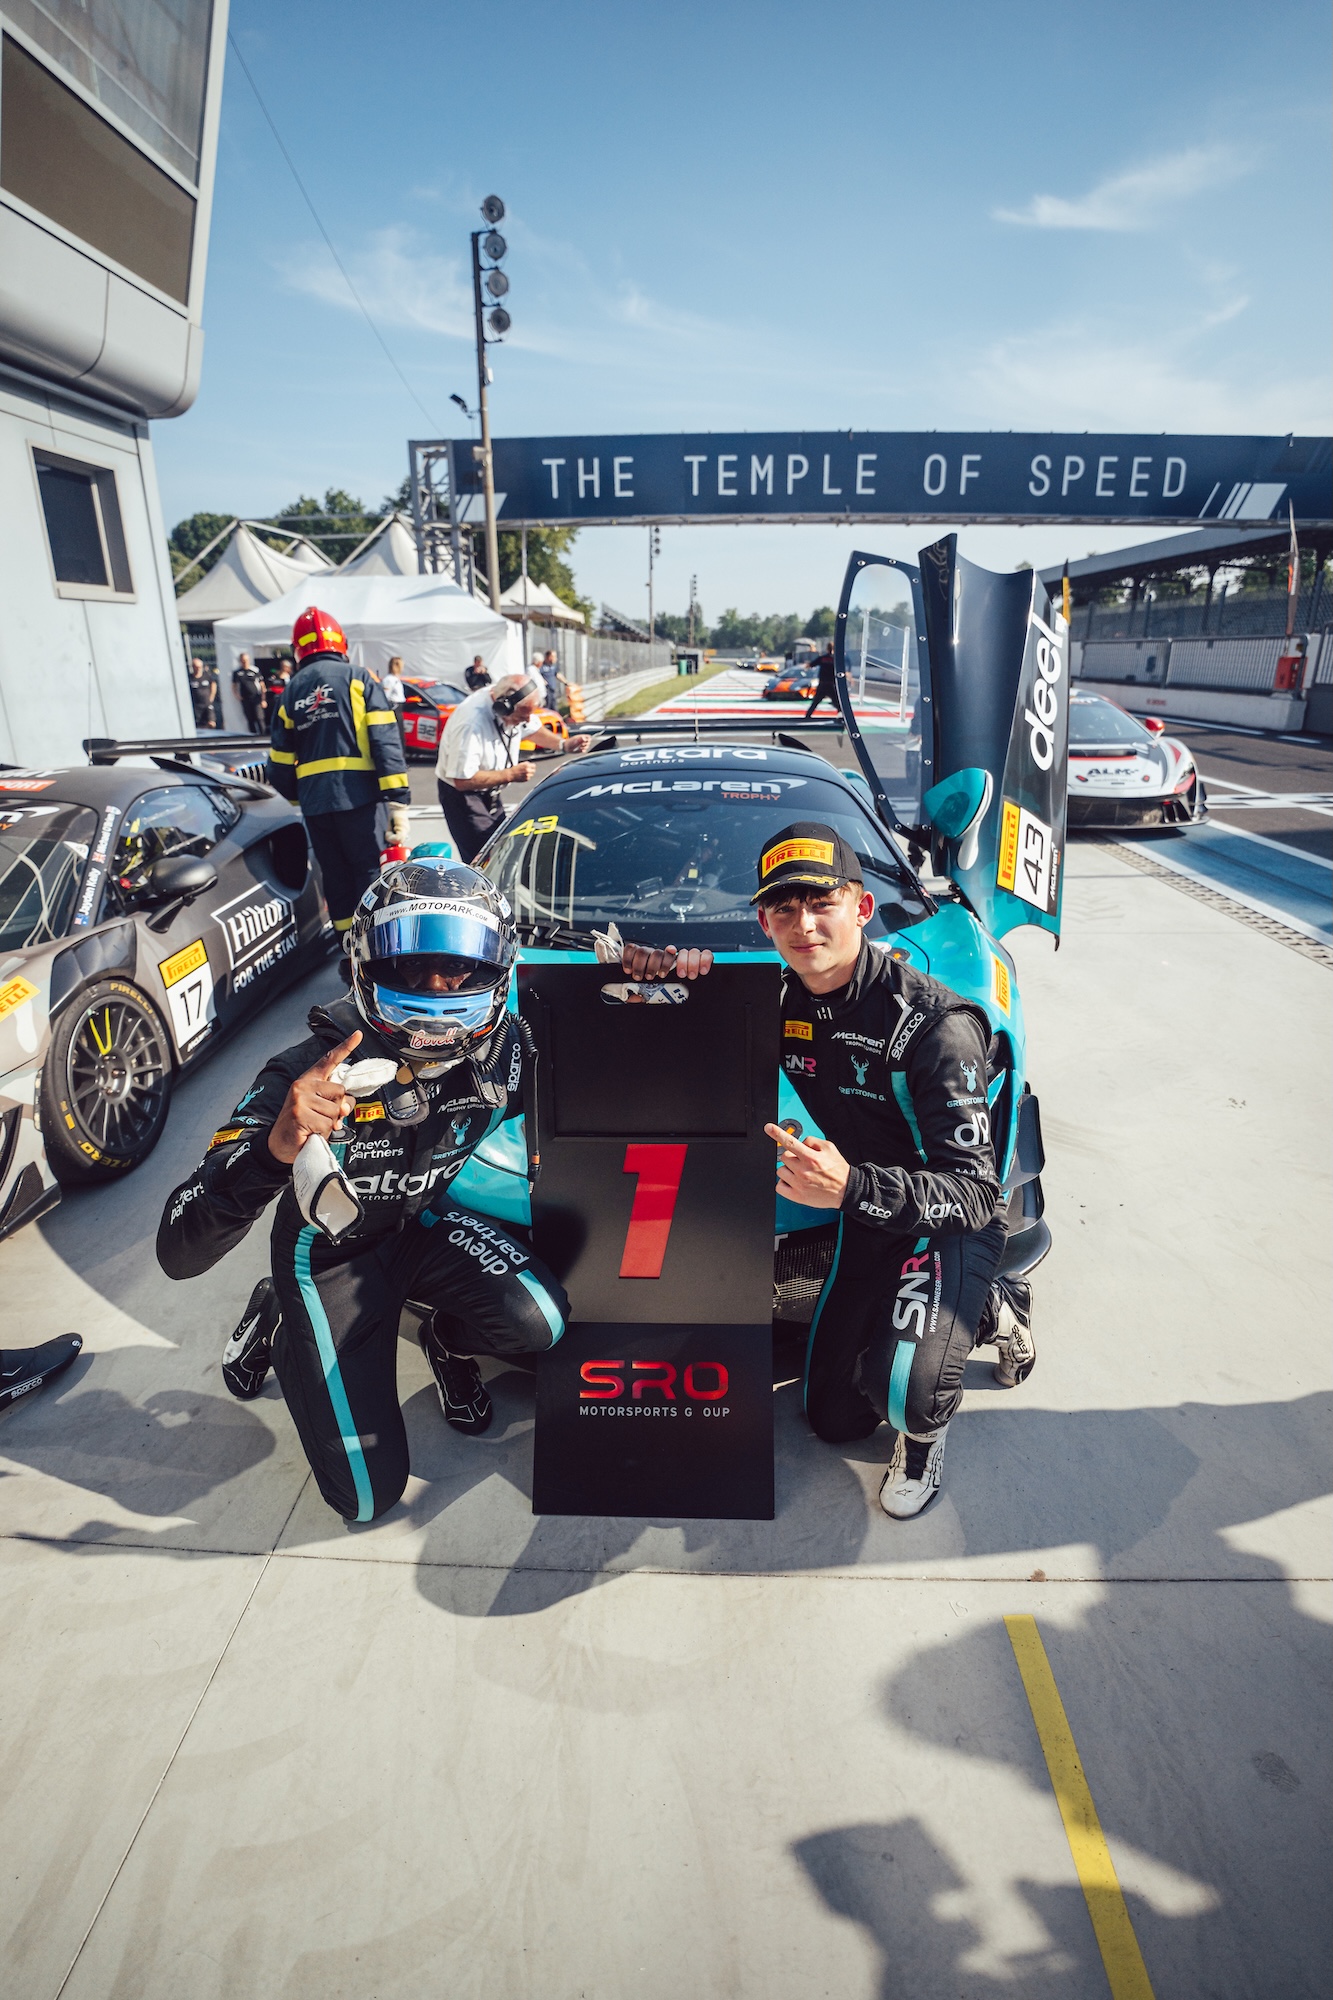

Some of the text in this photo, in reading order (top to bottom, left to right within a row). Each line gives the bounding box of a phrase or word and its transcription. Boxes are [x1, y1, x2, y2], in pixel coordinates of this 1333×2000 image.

[541, 453, 1188, 499] THE TEMPLE OF SPEED
[619, 748, 768, 762] atara
[619, 758, 685, 768] partners
[721, 792, 781, 801] TROPHY
[508, 815, 560, 837] 43
[1002, 810, 1017, 880] PIRELLI
[765, 843, 827, 871] PIRELLI
[1023, 823, 1044, 895] 43
[227, 898, 289, 953] Hilton
[166, 947, 202, 980] PIRELLI
[233, 967, 254, 994] FOR
[254, 948, 276, 975] THE
[995, 959, 1008, 1009] PIRELLI
[180, 979, 203, 1027] 17
[785, 1024, 809, 1037] RELLI
[891, 1011, 926, 1061] sparco
[507, 1042, 522, 1092] sparco
[348, 1146, 404, 1165] partners
[350, 1139, 390, 1153] dnevo
[618, 1143, 689, 1280] 1
[442, 1211, 529, 1266] partners
[448, 1229, 508, 1275] dnevo
[892, 1252, 930, 1340] SNR
[11, 1377, 43, 1399] sparco
[579, 1359, 729, 1401] SRO
[579, 1405, 678, 1417] MOTORSPORTS
